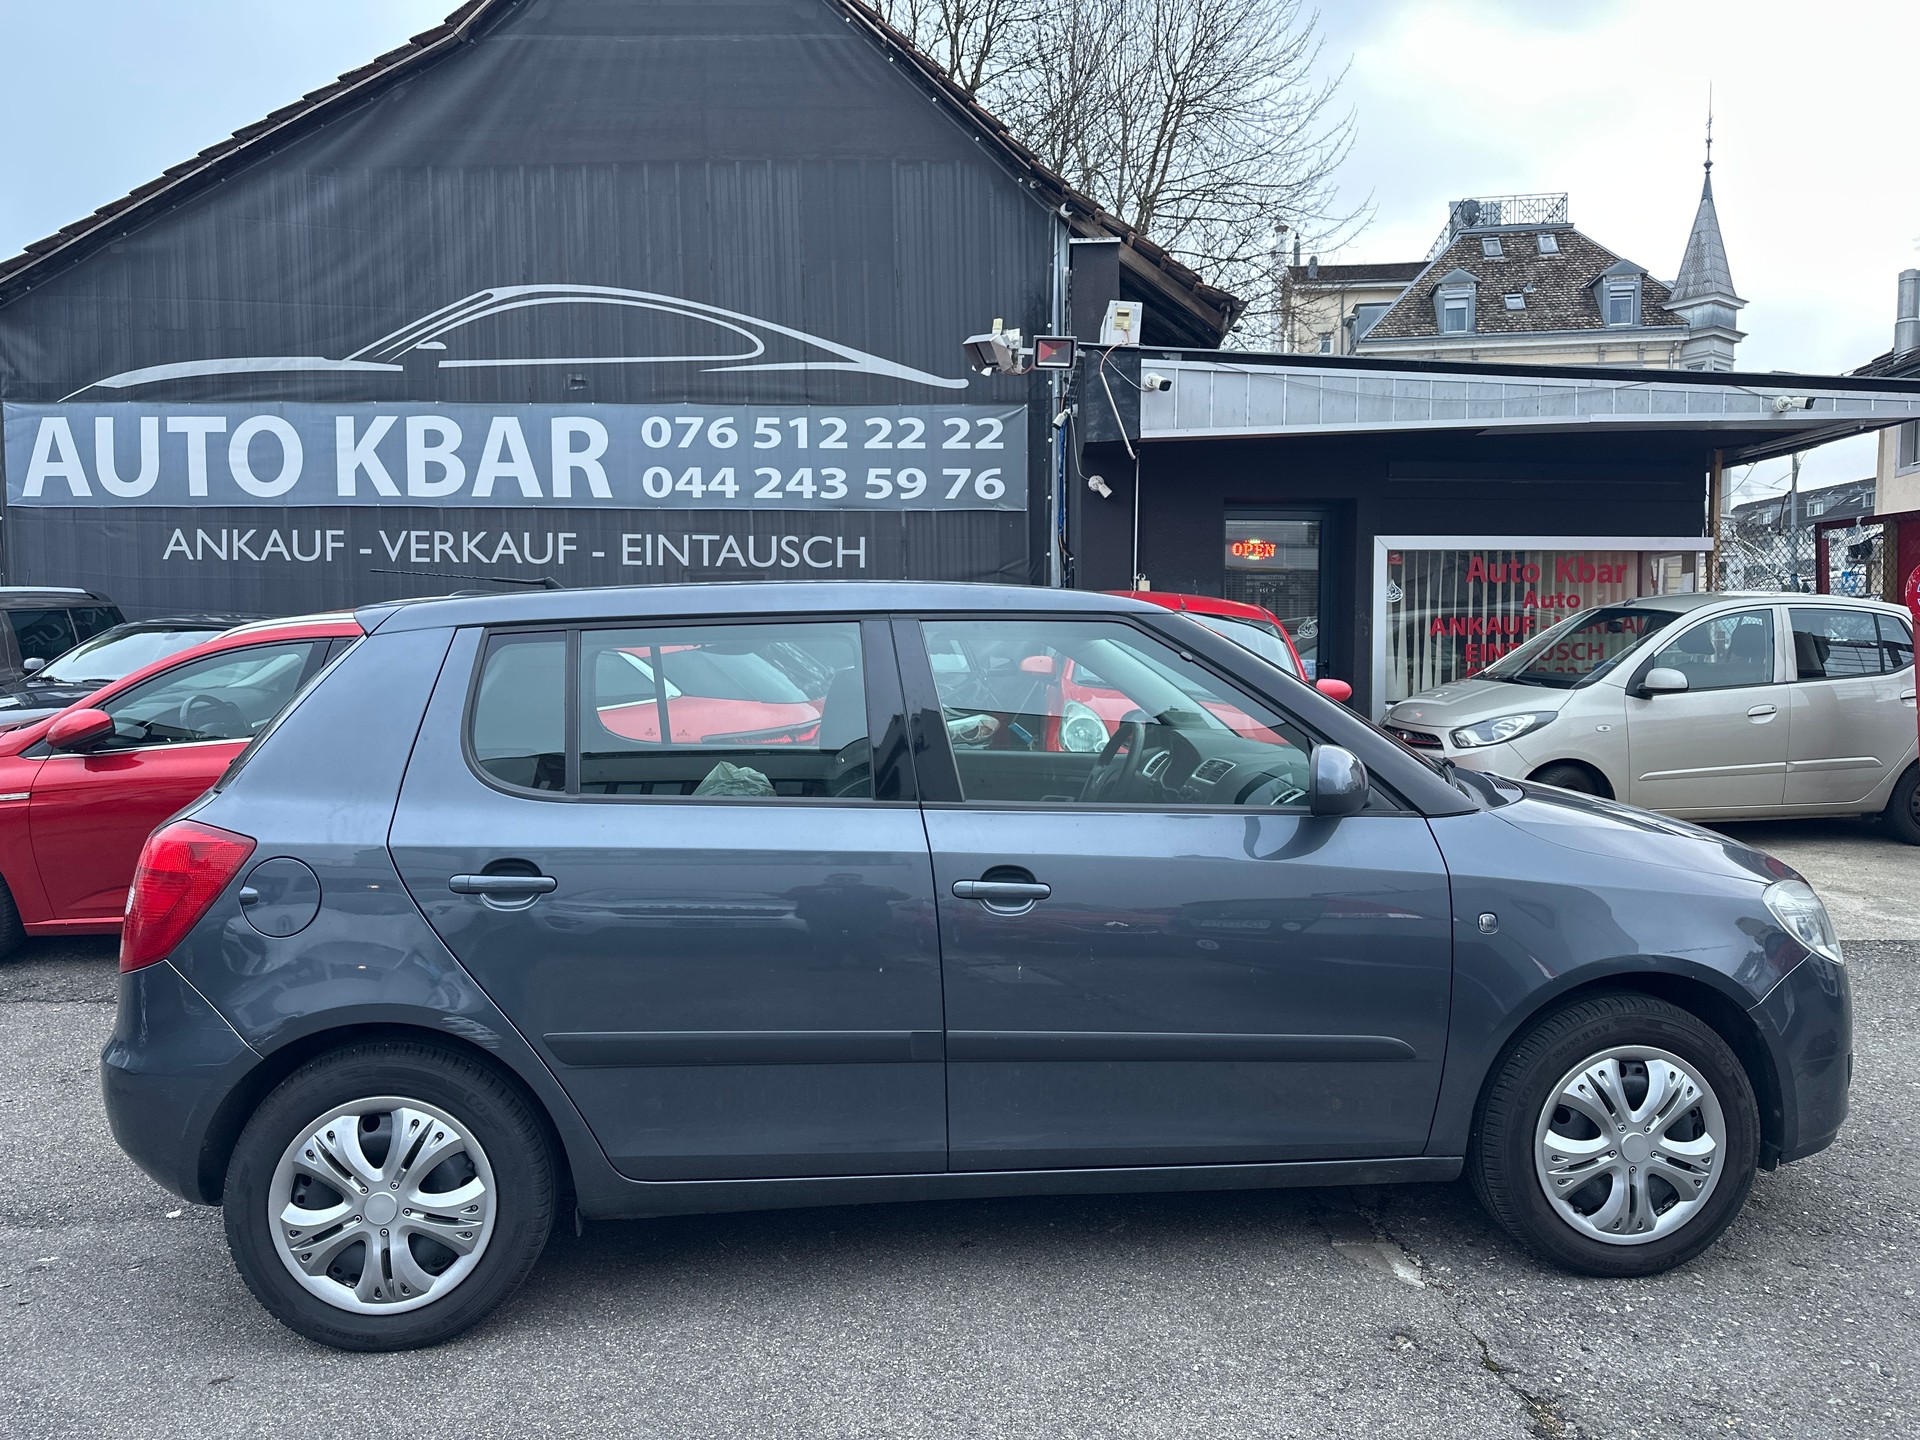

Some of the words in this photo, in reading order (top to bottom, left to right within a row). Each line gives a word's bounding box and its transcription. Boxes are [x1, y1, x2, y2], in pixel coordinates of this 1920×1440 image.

[641, 416, 738, 448] 076
[754, 417, 847, 449] 512
[864, 417, 925, 449] 22
[942, 418, 1003, 449] 22
[22, 415, 303, 497] AUTO
[336, 416, 612, 498] KBAR
[643, 467, 739, 498] 044
[754, 467, 847, 499] 243
[865, 468, 927, 499] 59
[943, 468, 1005, 499] 76
[163, 529, 344, 561] ANKAUF
[379, 531, 576, 564] VERKAUF
[623, 534, 865, 568] EINTAUSCH
[1231, 542, 1276, 557] OPEN
[1466, 556, 1541, 584] Auto
[1556, 555, 1628, 584] Kbar
[1523, 590, 1581, 609] Auto
[1430, 616, 1535, 637] ANKAUF
